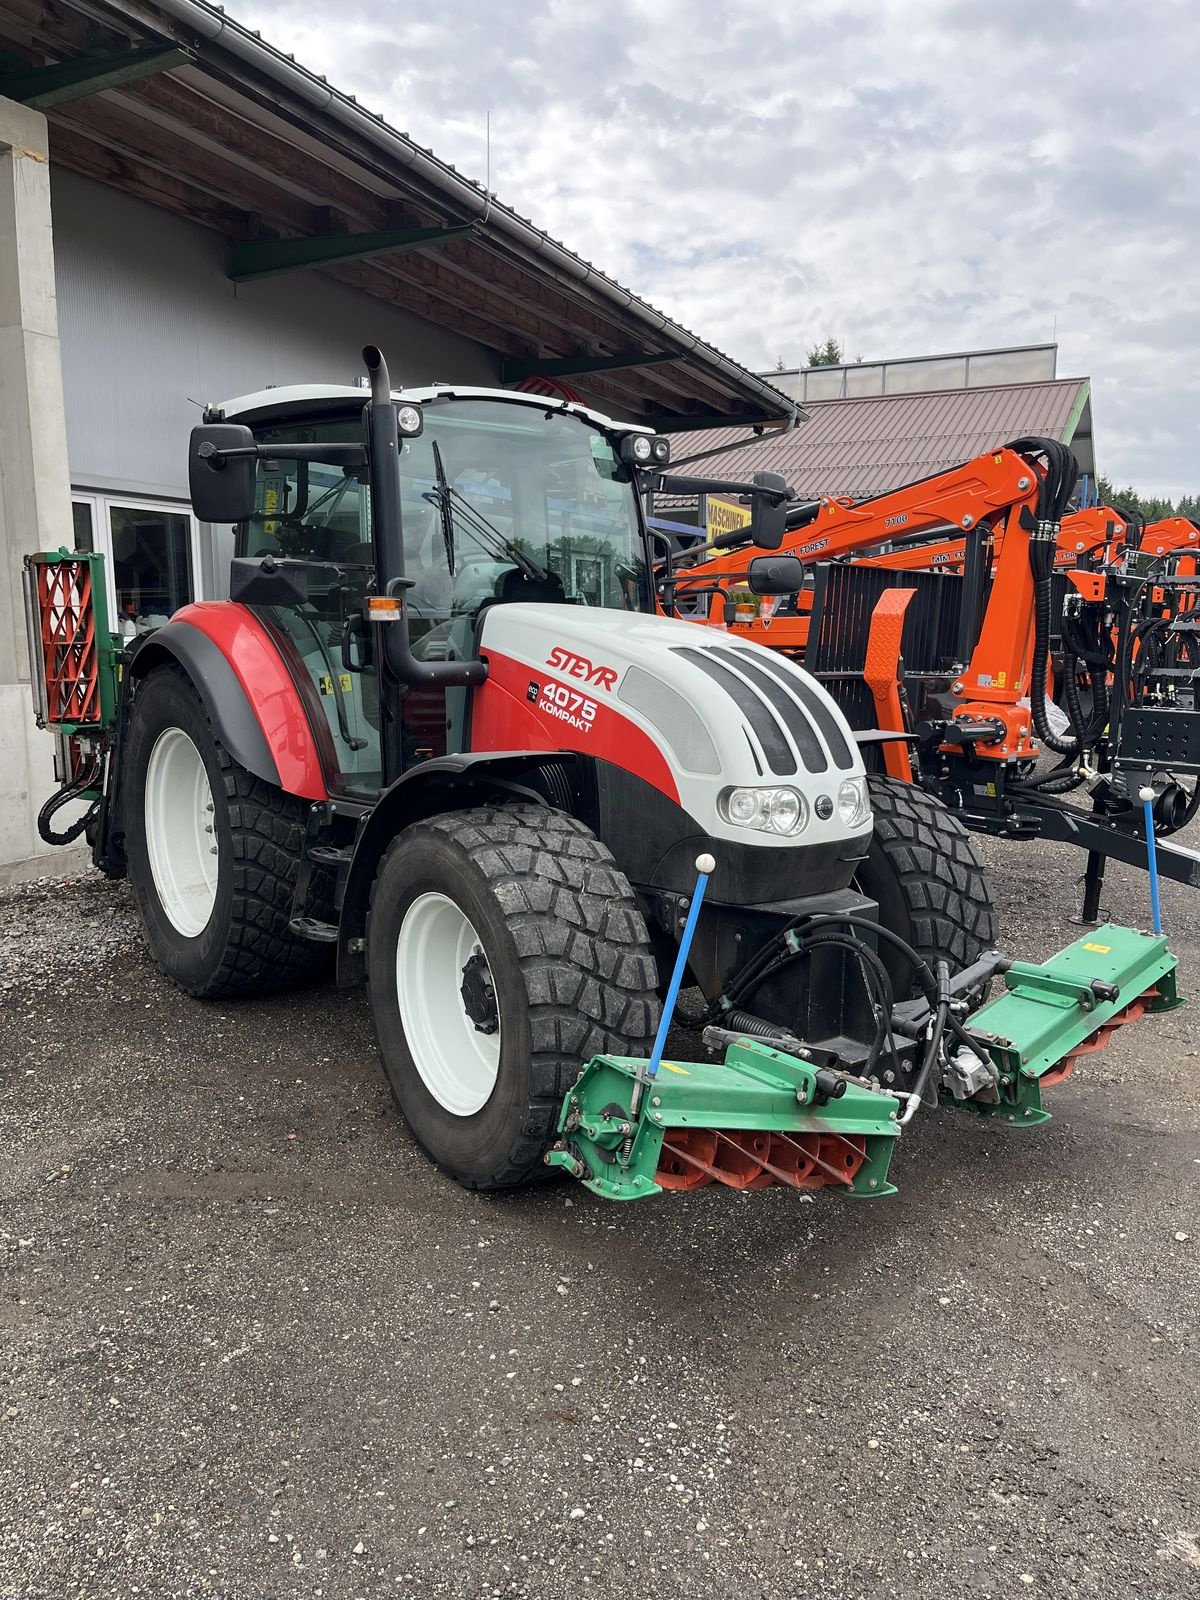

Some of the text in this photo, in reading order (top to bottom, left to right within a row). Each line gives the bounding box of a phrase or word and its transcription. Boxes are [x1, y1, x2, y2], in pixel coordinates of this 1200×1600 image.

[885, 513, 908, 528] 7100
[800, 538, 829, 555] FOREST
[931, 552, 951, 563] MTM
[545, 646, 618, 692] STEYR
[543, 682, 598, 721] 4075
[539, 699, 593, 733] KOMPAKT
